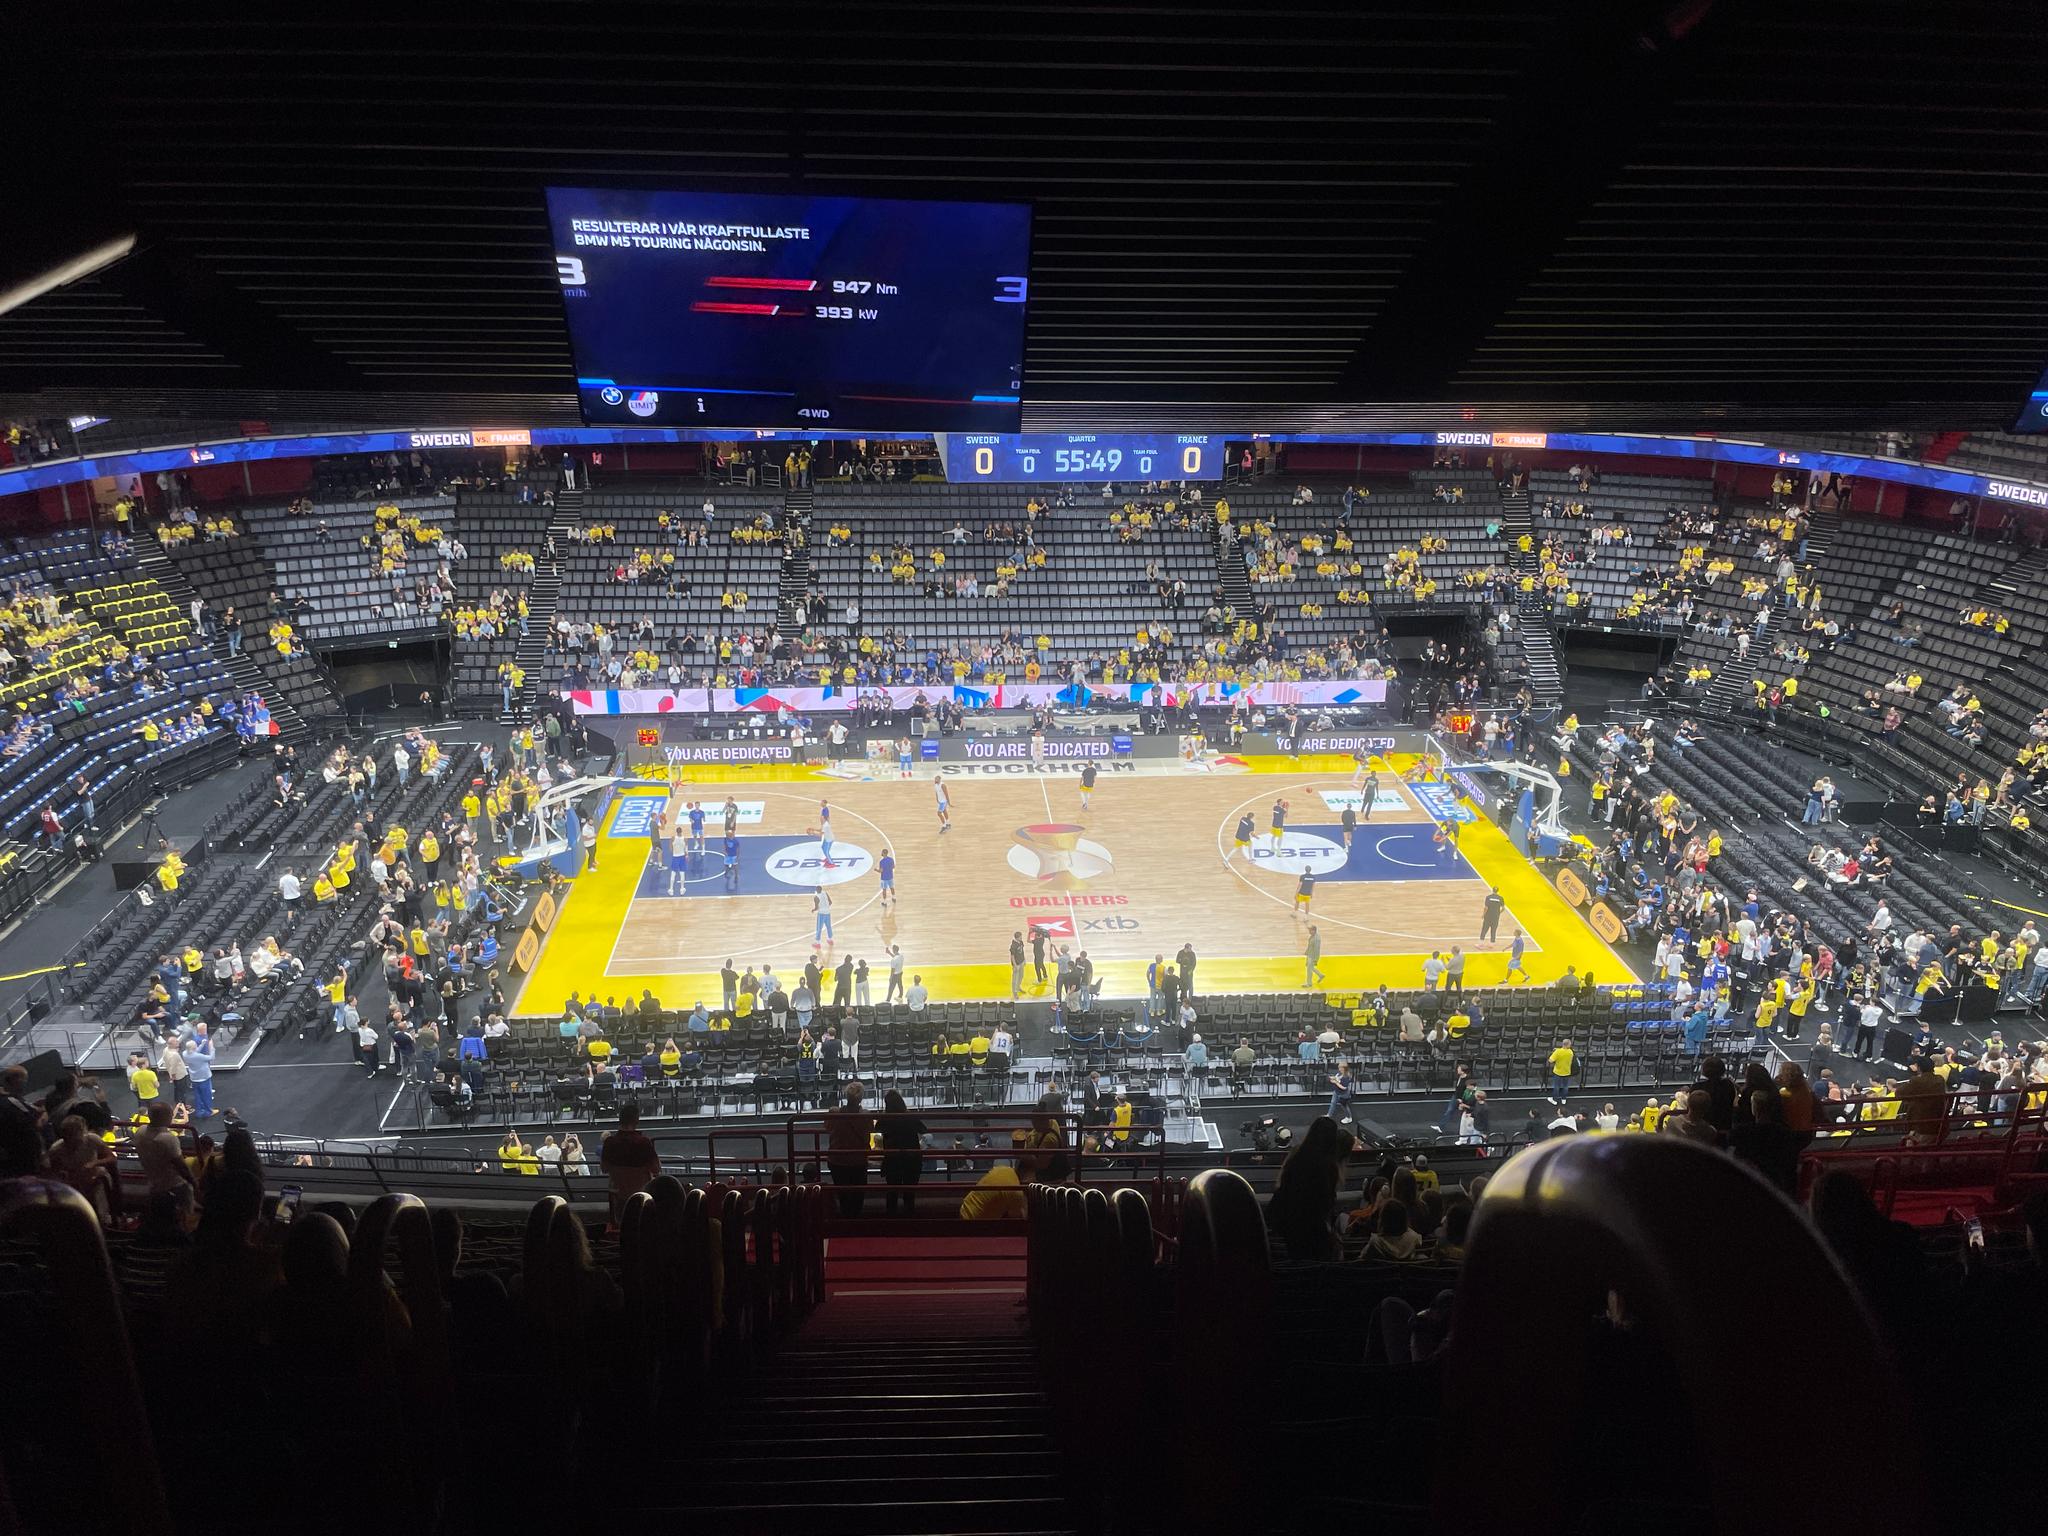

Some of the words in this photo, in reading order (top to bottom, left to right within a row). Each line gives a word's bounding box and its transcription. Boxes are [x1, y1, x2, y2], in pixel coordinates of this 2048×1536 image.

[572, 219, 659, 235] RESULTERAR
[662, 223, 667, 234] I
[669, 222, 697, 236] VÅR
[699, 224, 810, 239] KRAFTFULLASTE
[575, 235, 608, 246] BMW
[611, 236, 630, 247] M5
[632, 237, 691, 250] TOURING
[694, 237, 766, 252] NÅGONSIN.
[832, 280, 872, 294] 947
[876, 283, 898, 295] Nm
[815, 306, 853, 319] 393
[859, 307, 878, 320] kW
[630, 402, 654, 410] LIMIT
[797, 408, 830, 418] 4WD
[411, 433, 470, 446] SWEDEN
[491, 434, 527, 443] FRANCE
[966, 436, 1000, 444] SWEDEN
[1068, 435, 1096, 443] QUARTER
[1178, 436, 1208, 444] FRANCE
[1437, 432, 1490, 445] SWEDEN
[1508, 436, 1543, 444] FRANCE
[975, 447, 993, 474] 0
[1023, 456, 1035, 473] 0
[1055, 450, 1122, 473] 55:49
[1140, 457, 1151, 474] 0
[1183, 446, 1201, 473] 0
[1988, 482, 2048, 505] SWEDEN
[965, 742, 994, 758] YOU
[997, 743, 1026, 757] ARE
[1031, 742, 1110, 757] EDICATED
[1302, 738, 1326, 750] ARE
[692, 748, 719, 761] ARE
[722, 746, 792, 760] DEDICATED
[942, 762, 1136, 775] STOCKHOLM
[1009, 895, 1129, 908] QUALIFIERS
[1081, 915, 1140, 930] xtb
[997, 1039, 1006, 1048] 13
